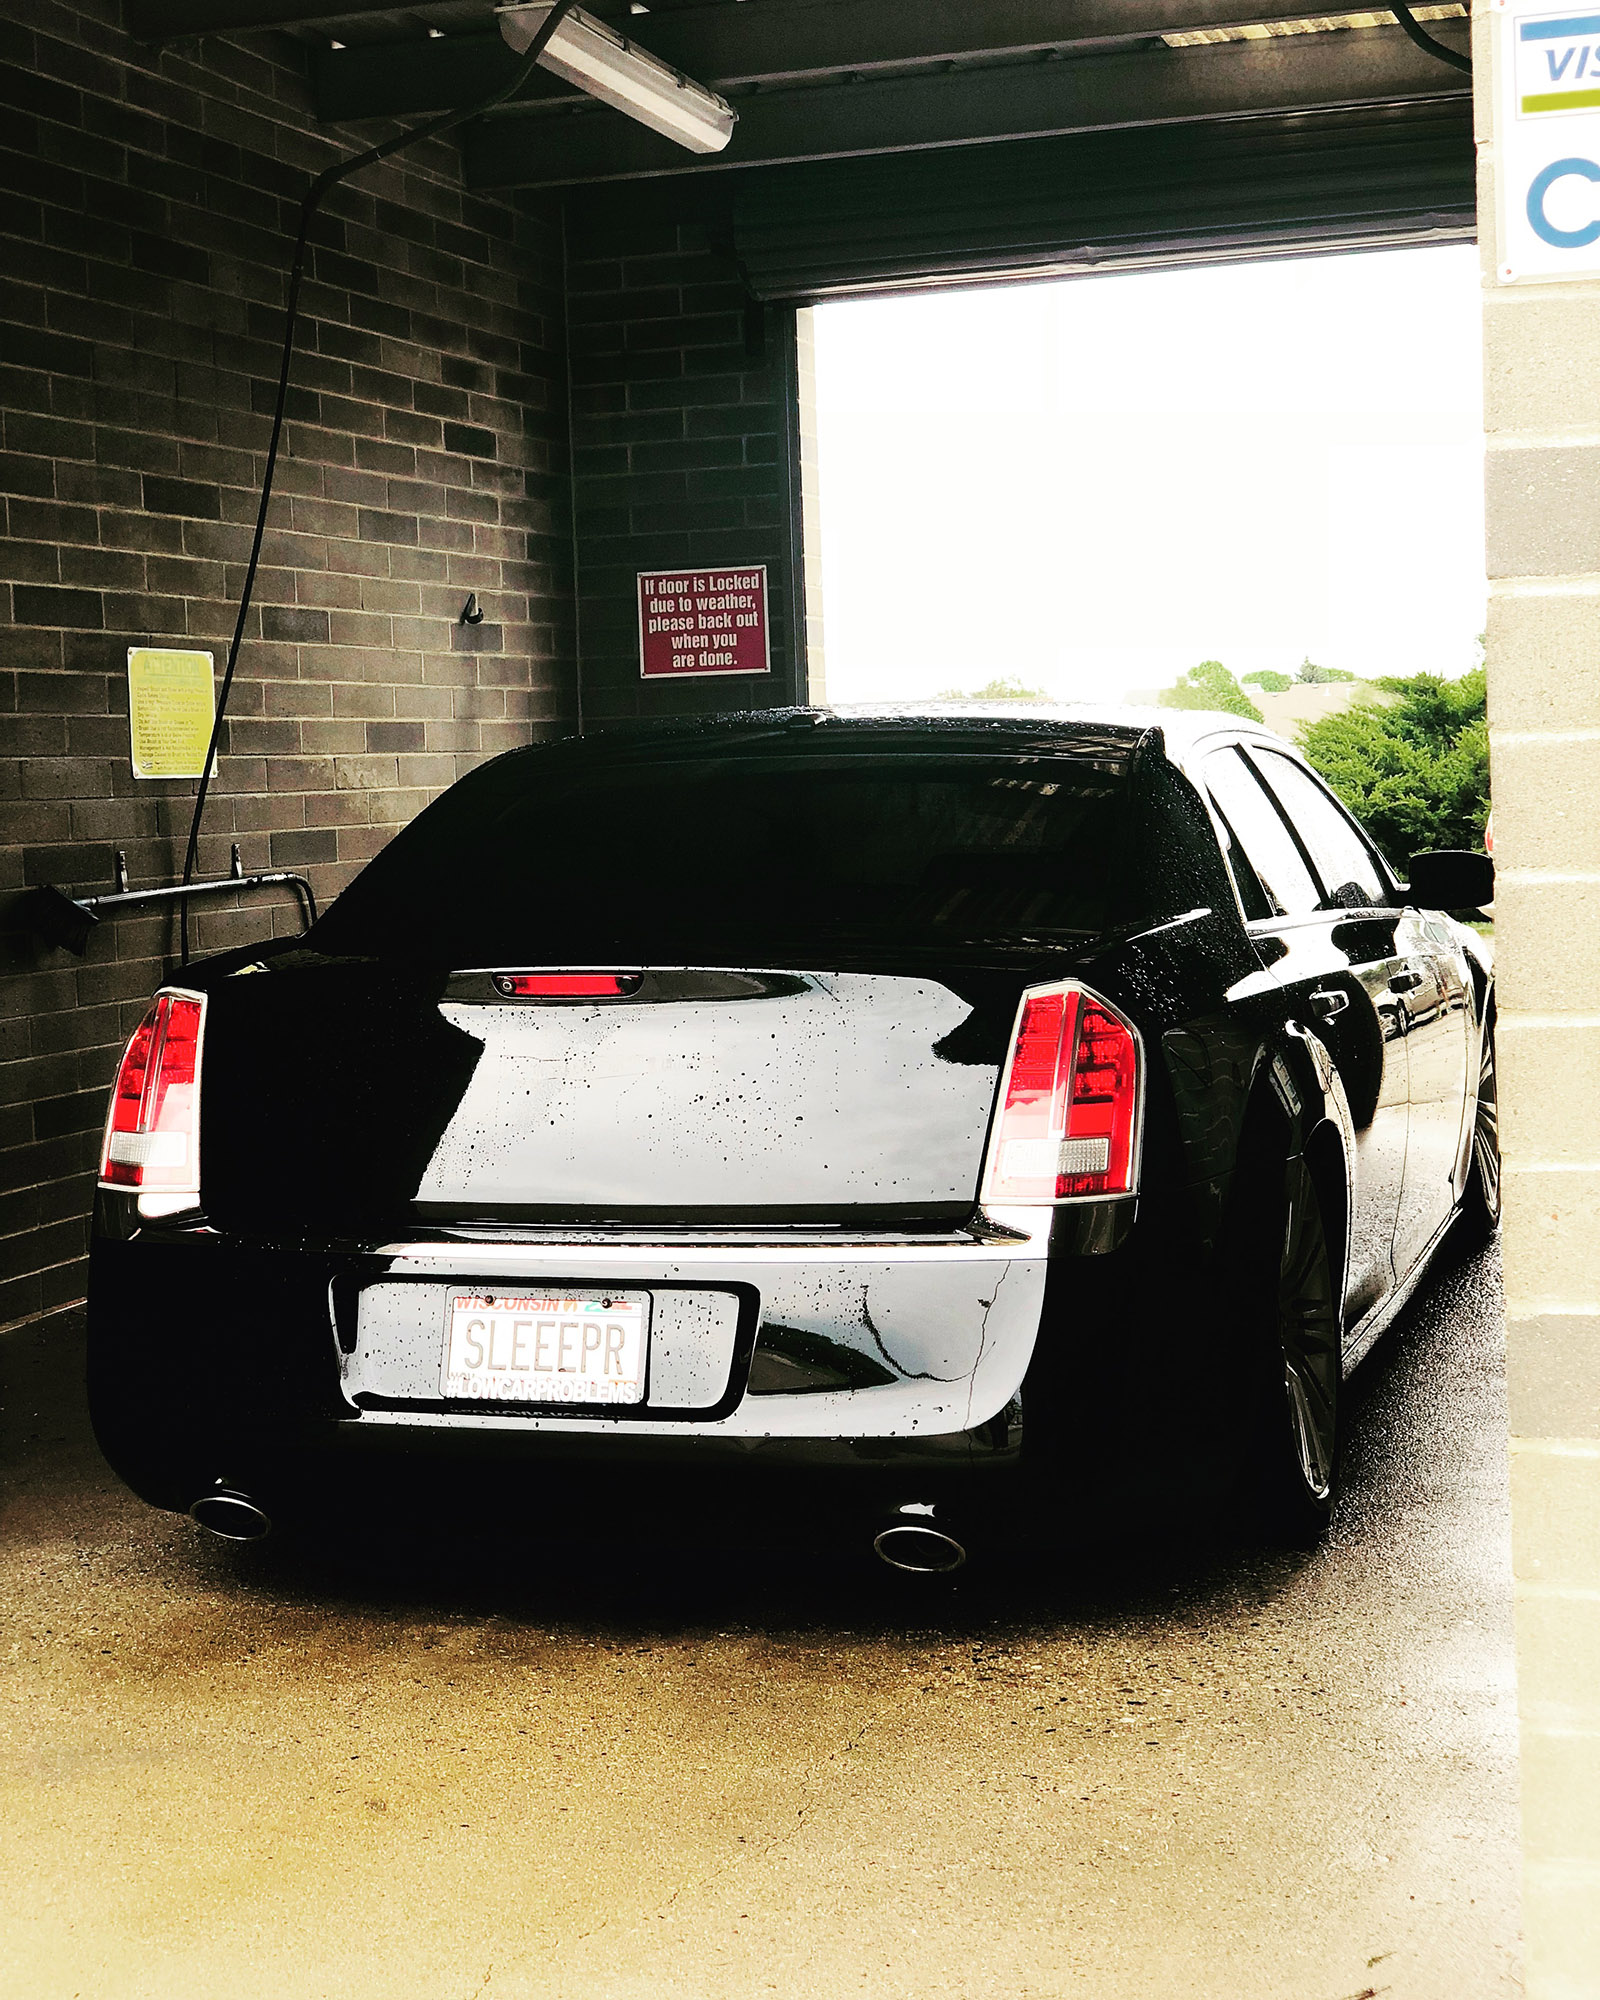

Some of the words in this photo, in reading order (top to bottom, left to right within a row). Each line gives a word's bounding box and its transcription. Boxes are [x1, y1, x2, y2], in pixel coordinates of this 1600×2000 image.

[644, 579, 655, 595] If
[658, 578, 689, 594] door
[693, 577, 705, 592] is
[709, 573, 760, 592] Locked
[649, 598, 675, 614] due
[679, 597, 692, 612] to
[696, 593, 756, 611] weather,
[648, 616, 694, 634] please
[698, 612, 732, 630] back
[736, 611, 759, 627] out
[671, 633, 709, 649] when
[712, 633, 737, 650] you
[143, 655, 200, 675] ATTENTION
[672, 655, 695, 668] are
[698, 651, 738, 667] done.
[464, 1319, 626, 1375] SLEEEPR
[446, 1376, 637, 1404] #LOWCARPROBLEMS
